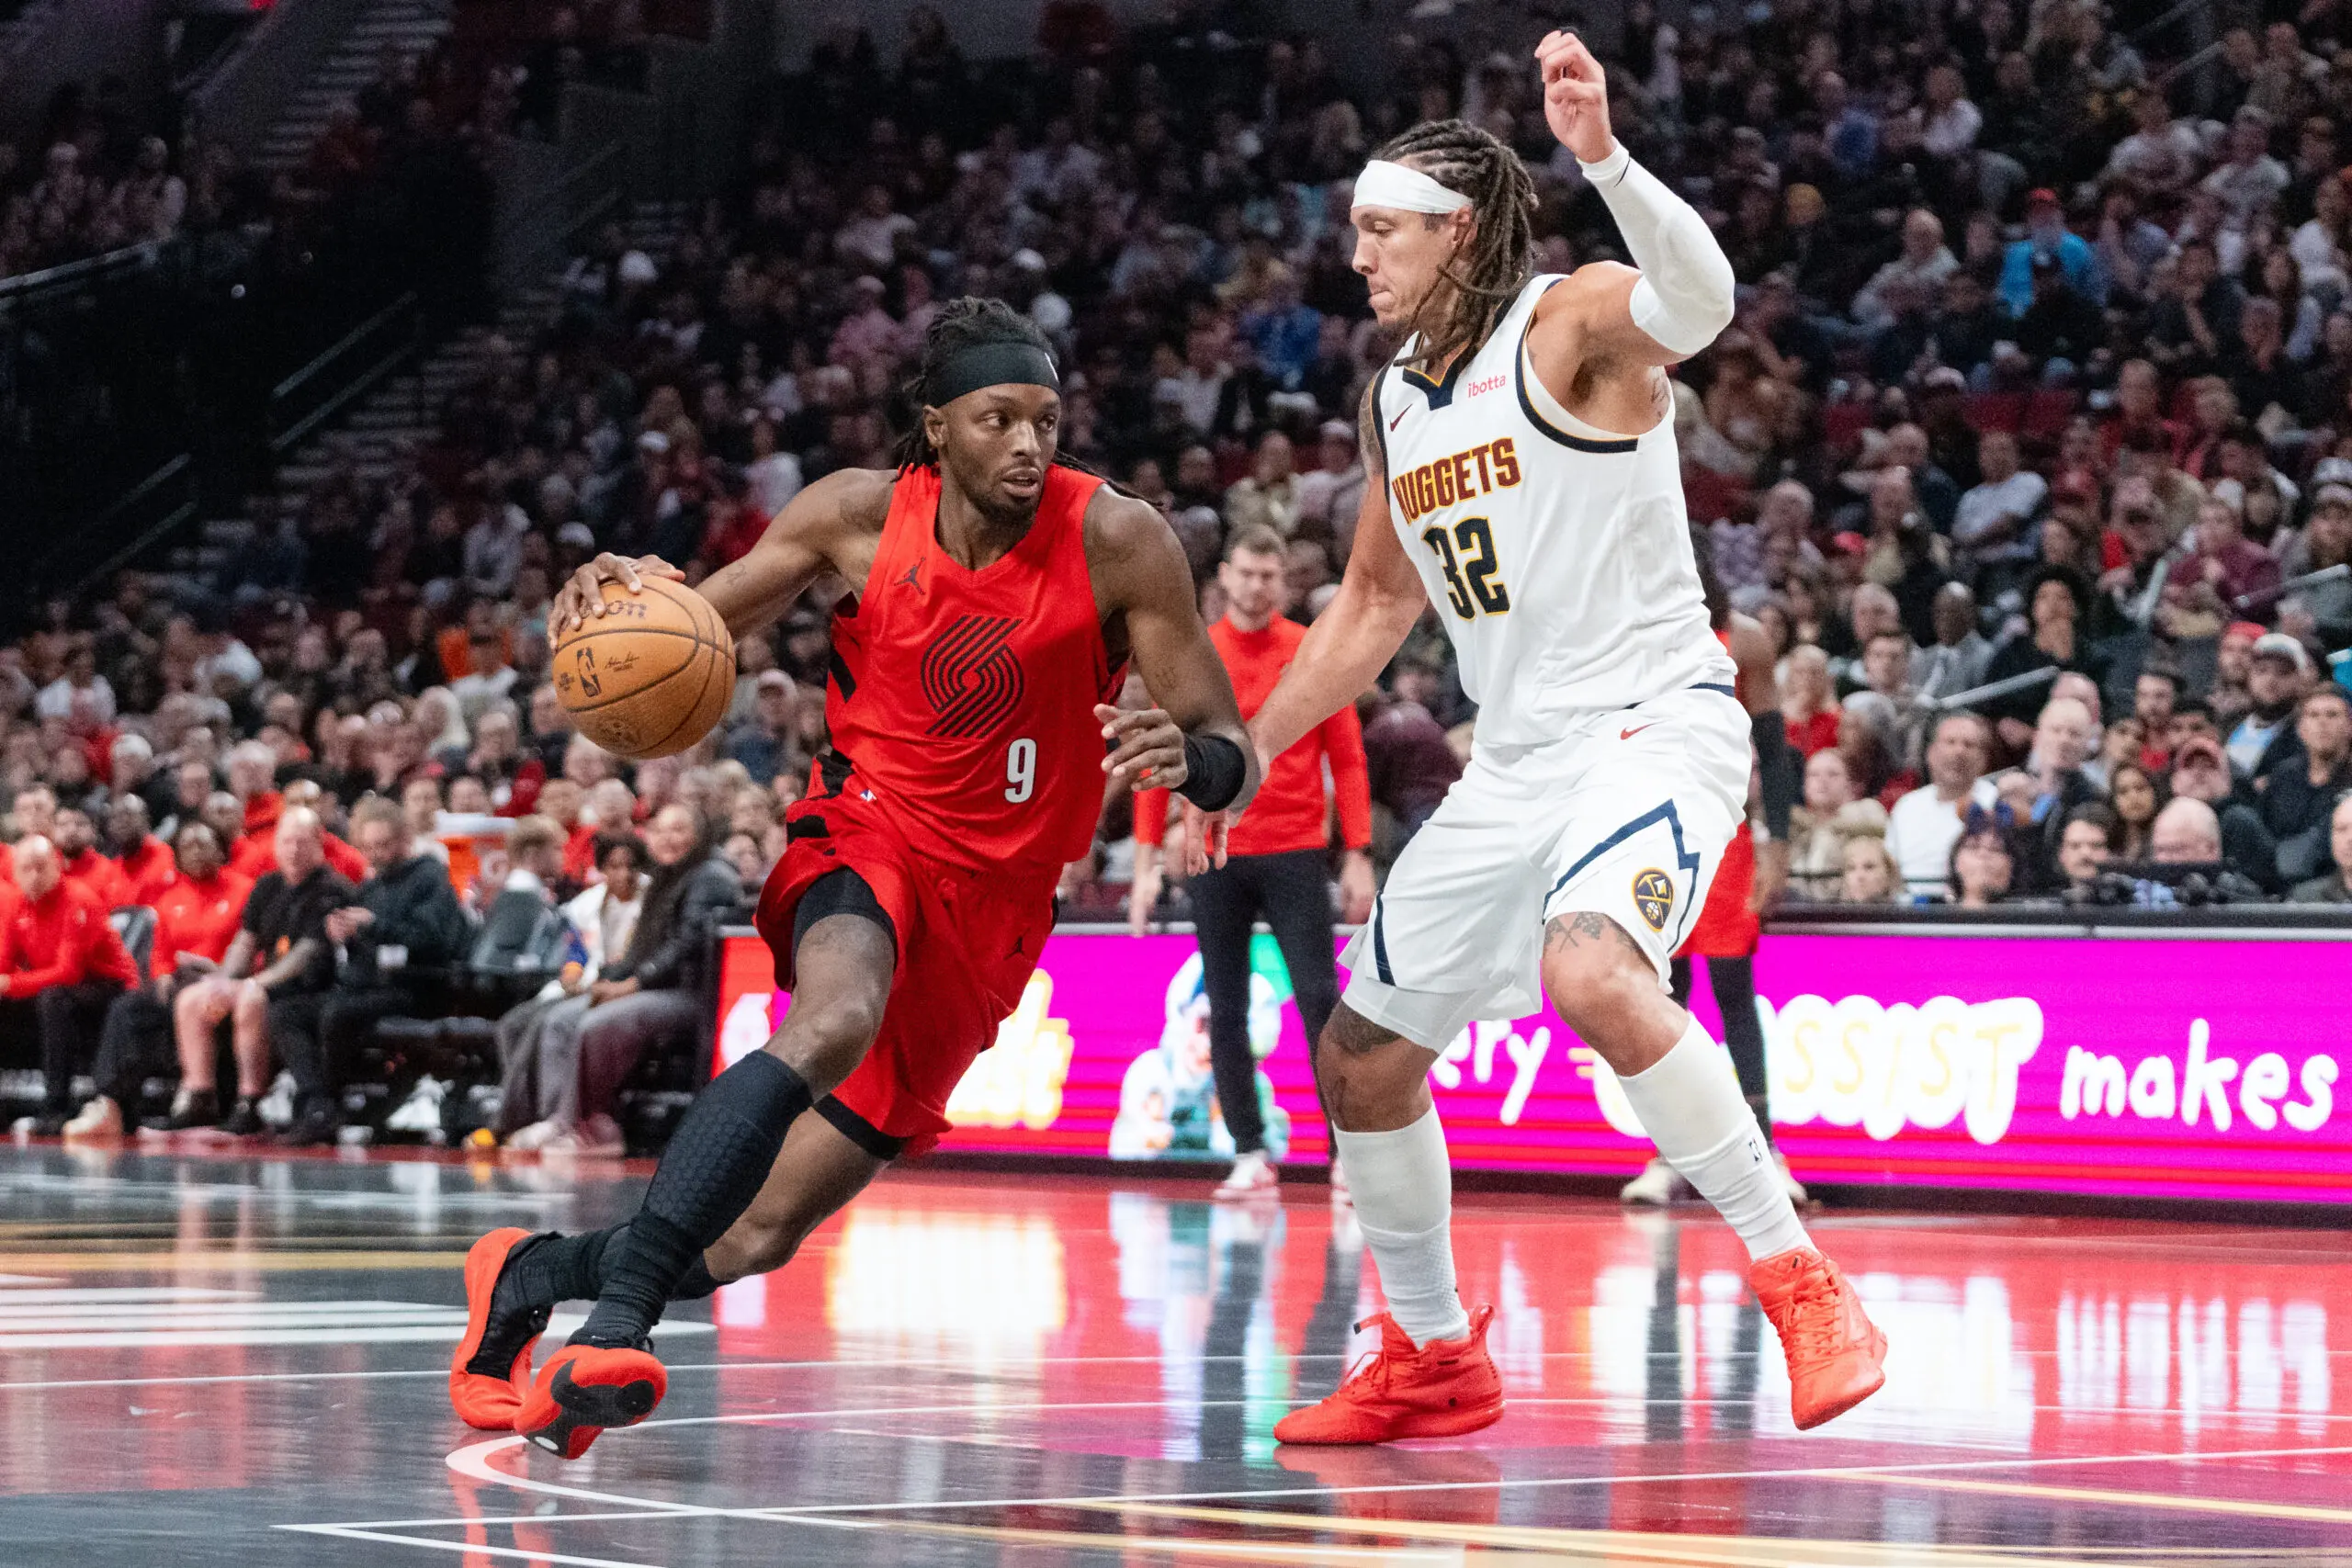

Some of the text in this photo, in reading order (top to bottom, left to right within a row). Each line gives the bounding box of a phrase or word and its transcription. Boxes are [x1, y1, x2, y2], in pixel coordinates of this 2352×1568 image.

[1468, 375, 1507, 399] ibotta
[1391, 437, 1521, 526] NUGGETS
[1421, 516, 1510, 622] 32
[1004, 738, 1036, 804] 9
[1755, 993, 2043, 1145] SSIST
[2059, 1018, 2339, 1133] makes
